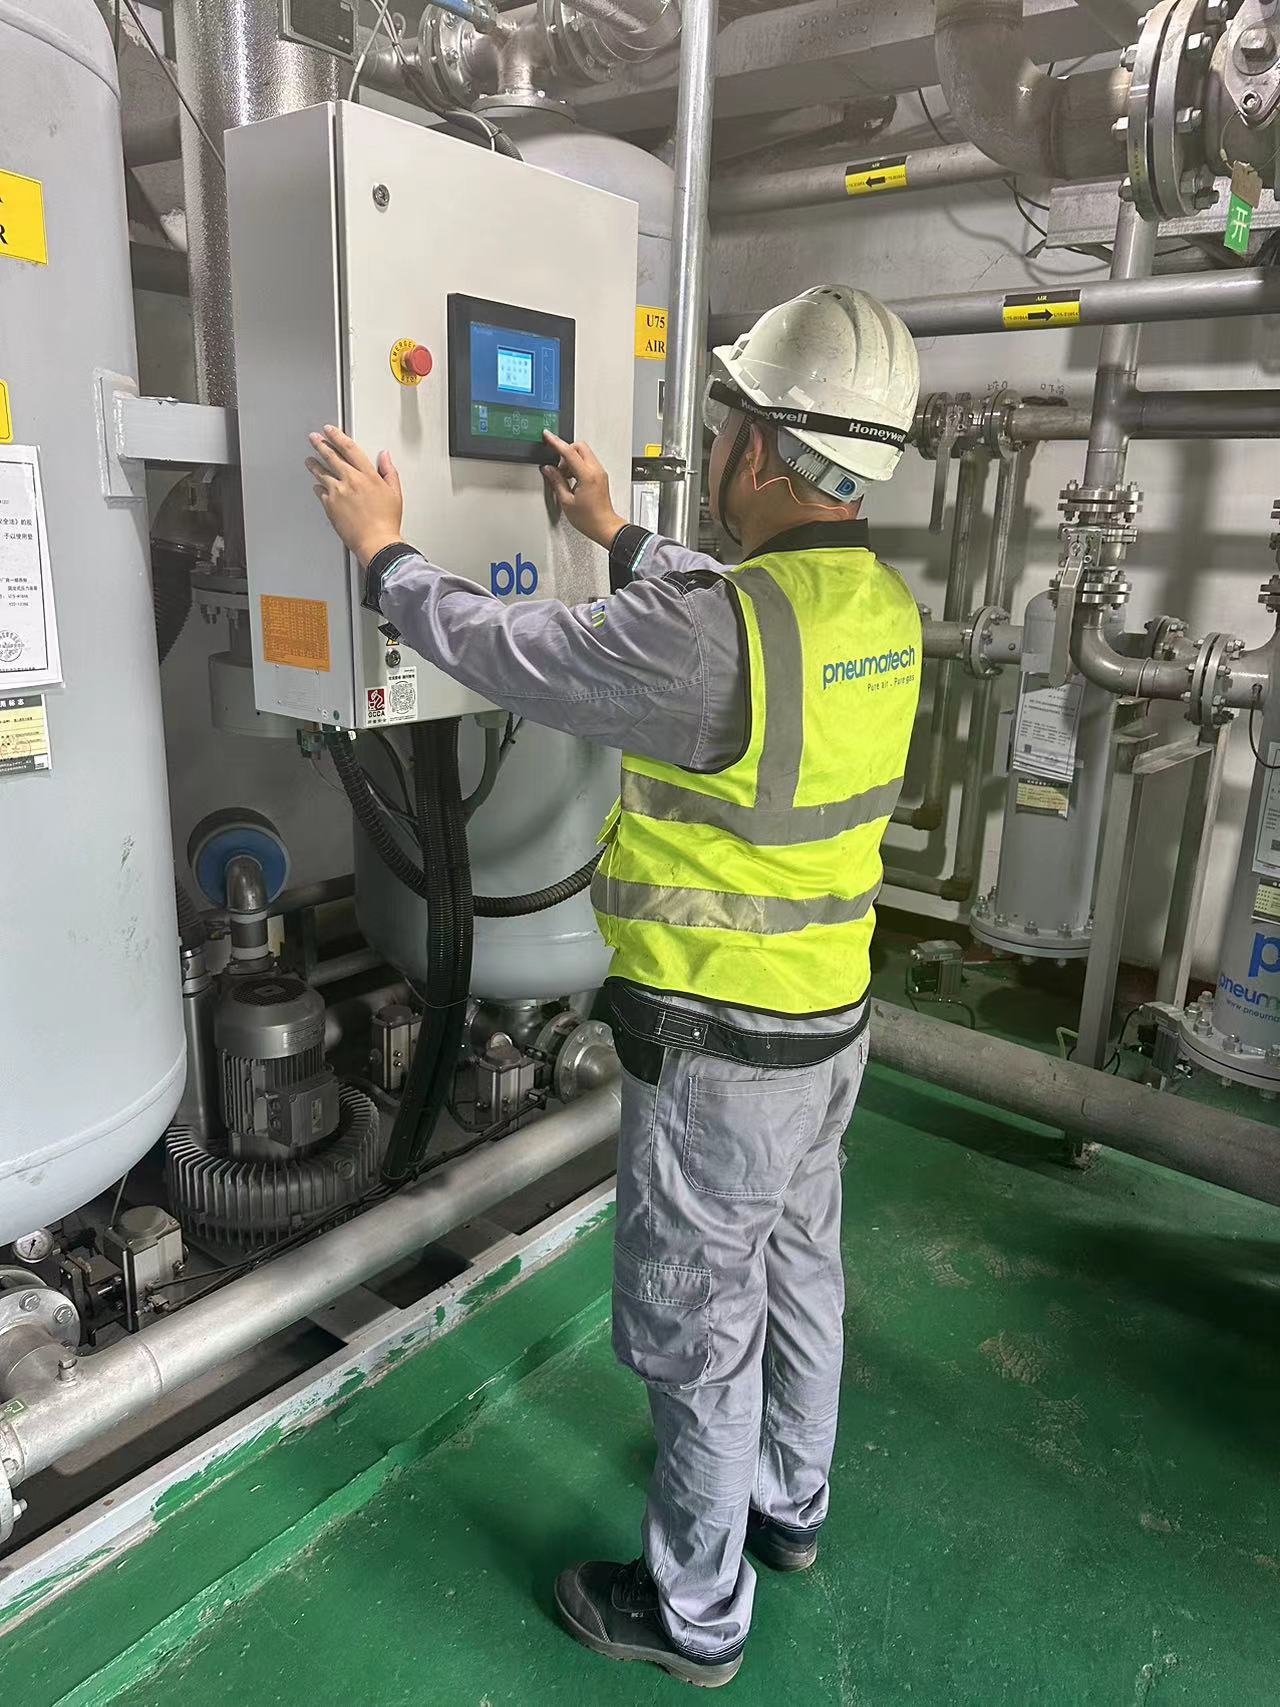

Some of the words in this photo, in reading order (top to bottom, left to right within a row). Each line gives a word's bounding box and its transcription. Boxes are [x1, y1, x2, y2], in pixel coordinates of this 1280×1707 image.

[1231, 206, 1249, 243] 开
[646, 314, 665, 328] U75
[645, 339, 665, 353] AIR
[490, 552, 539, 597] pb
[823, 644, 915, 691] pneumatech
